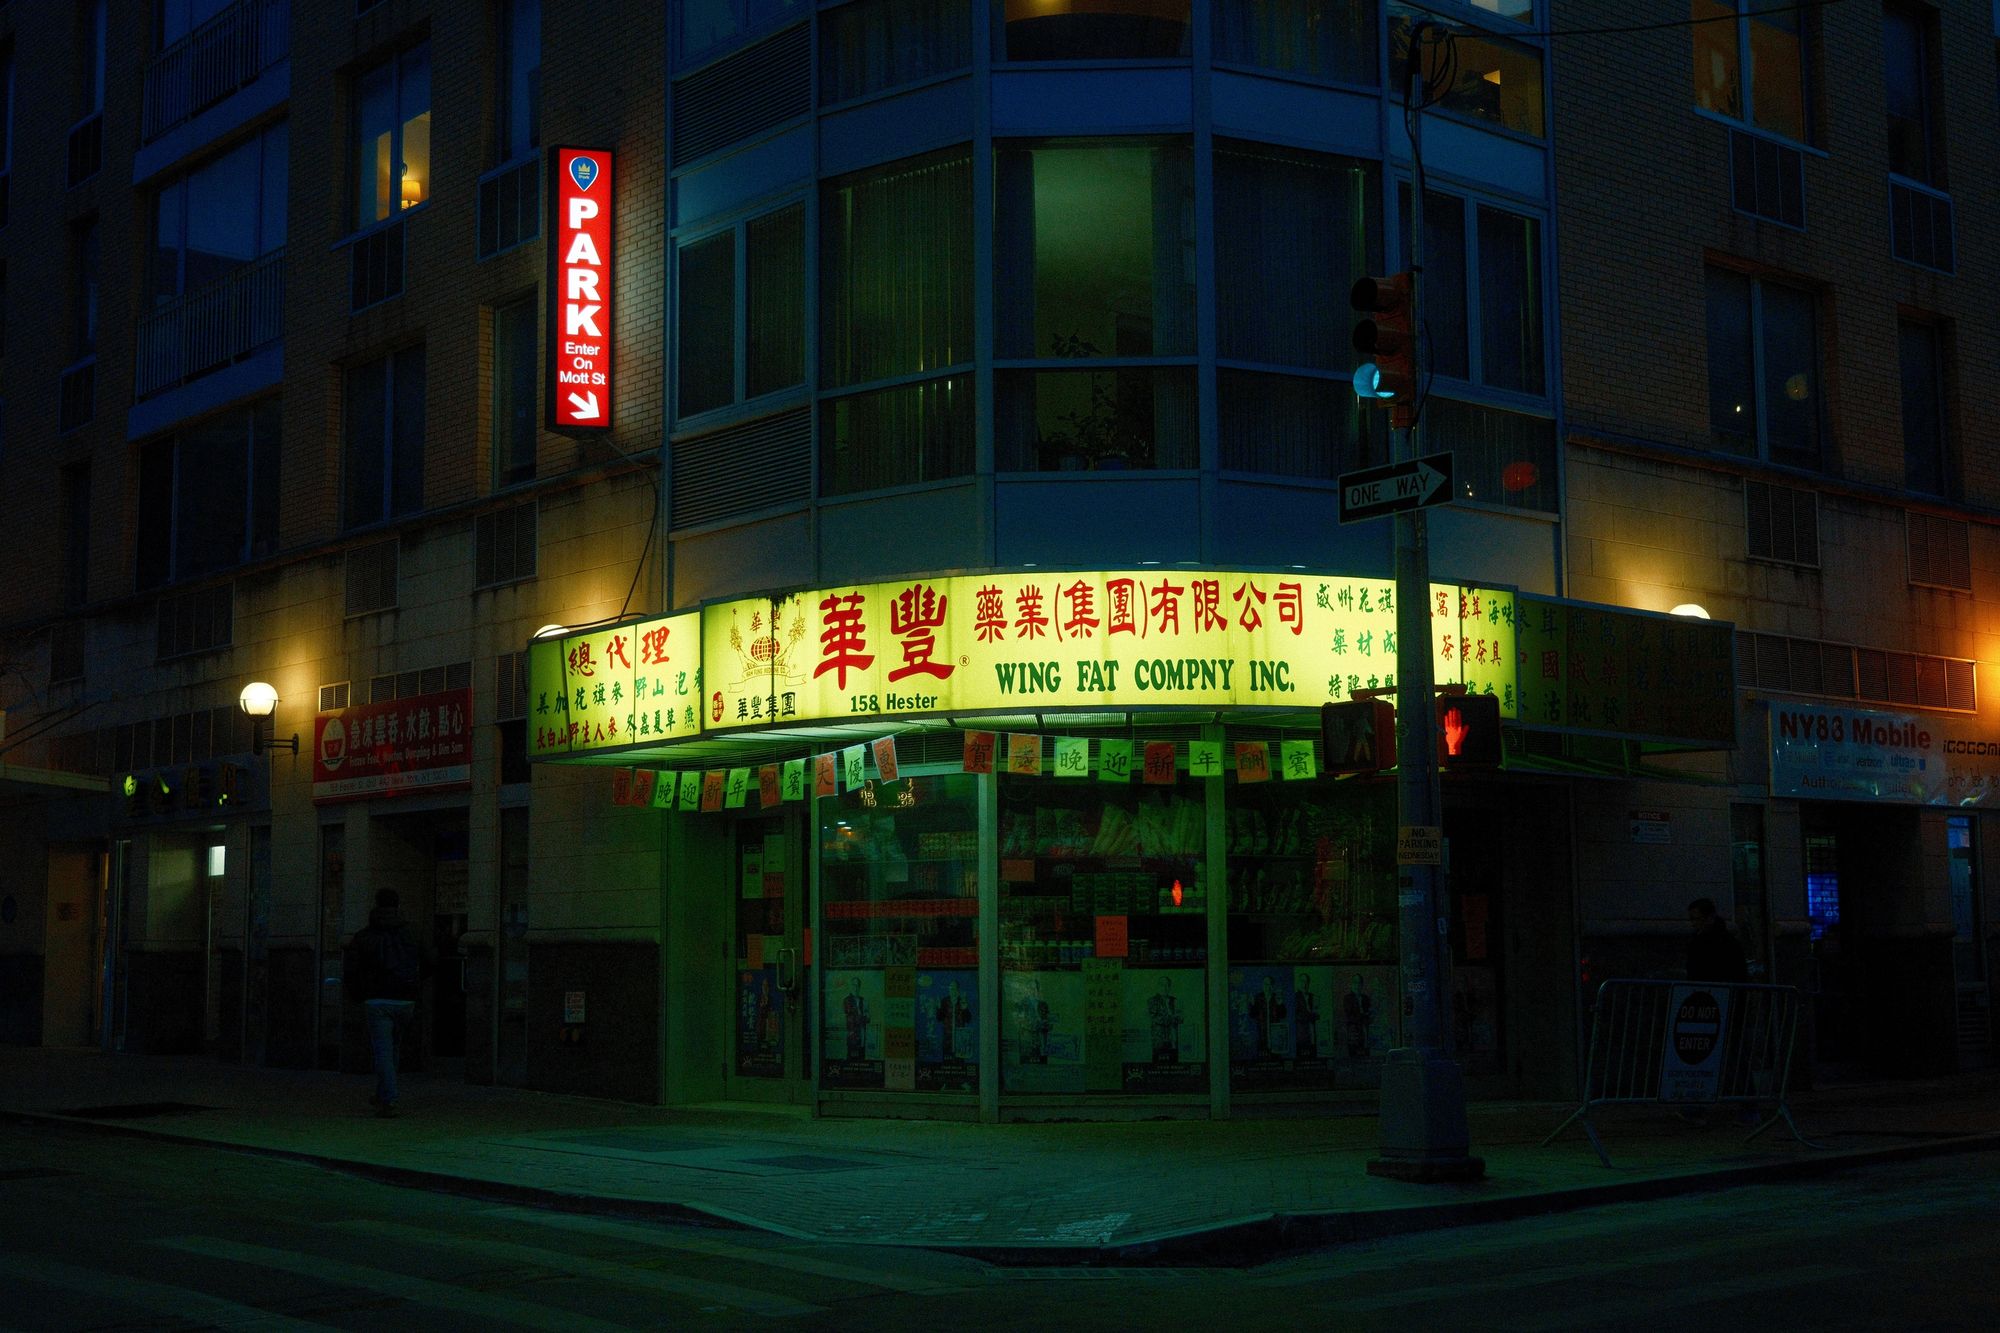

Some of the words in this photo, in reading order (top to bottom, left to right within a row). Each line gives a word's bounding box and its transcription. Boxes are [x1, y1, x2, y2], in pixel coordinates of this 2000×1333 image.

[566, 198, 602, 337] PARK
[565, 342, 600, 356] Enter
[573, 357, 592, 370] On
[560, 370, 588, 384] Mott
[592, 371, 605, 385] St
[1352, 484, 1381, 505] ONE
[1397, 472, 1430, 496] WAY
[813, 584, 955, 690] 華豐
[568, 626, 671, 677] 總代理
[995, 661, 1061, 694] WING
[1076, 659, 1119, 692] FAT
[1134, 658, 1234, 692] COMPNY
[1249, 660, 1295, 692] INC.
[737, 692, 796, 722] 華豐集團
[851, 695, 879, 712] 158
[886, 693, 938, 710] Hester
[1780, 711, 1844, 742] NY88
[1852, 718, 1931, 749] Mobile
[1412, 828, 1425, 837] NO
[1399, 840, 1438, 849] PARKING
[1681, 1006, 1695, 1019] DO
[1697, 1006, 1716, 1019] NOT
[1680, 1037, 1711, 1050] ENTER
